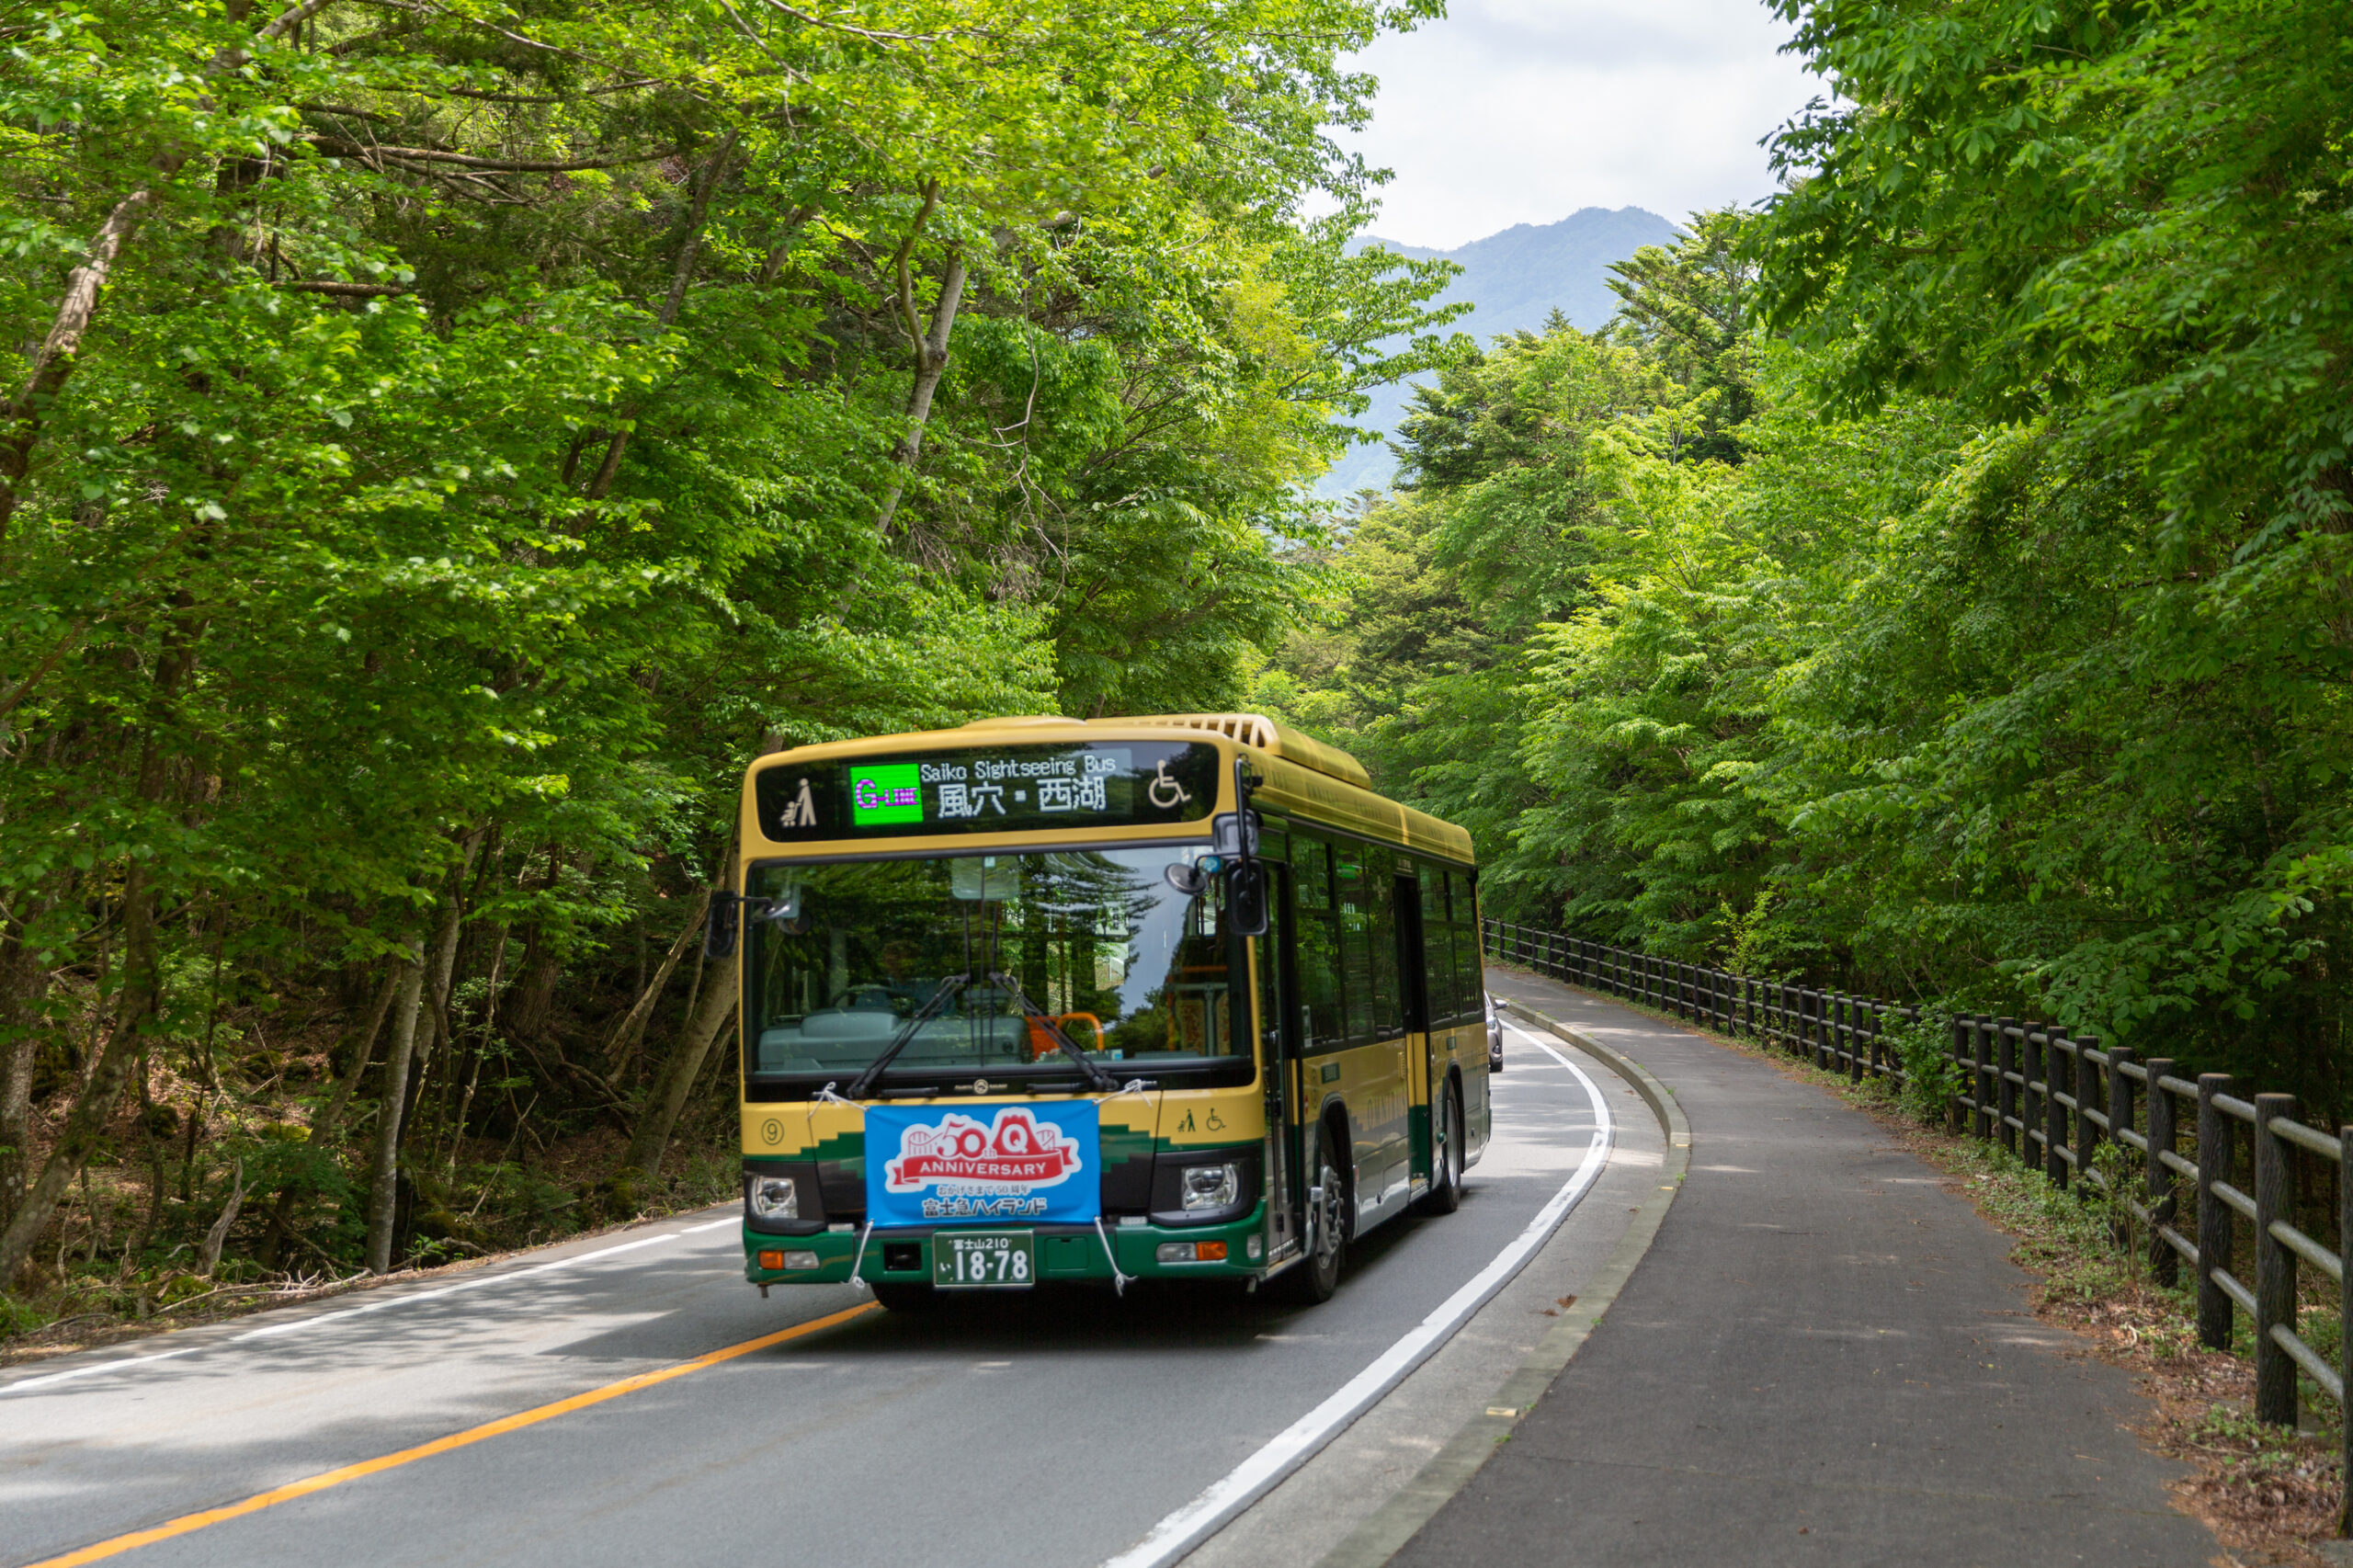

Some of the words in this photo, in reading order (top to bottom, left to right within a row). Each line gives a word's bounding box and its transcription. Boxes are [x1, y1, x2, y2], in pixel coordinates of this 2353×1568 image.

[920, 763, 967, 781] Saiko
[974, 757, 1075, 780] Sightseeing
[1084, 755, 1117, 774] Bus
[919, 1161, 1047, 1176] ANNIVERSARY
[923, 1198, 1046, 1217] 富士急ハイランド
[957, 1250, 1029, 1280] 18-78
